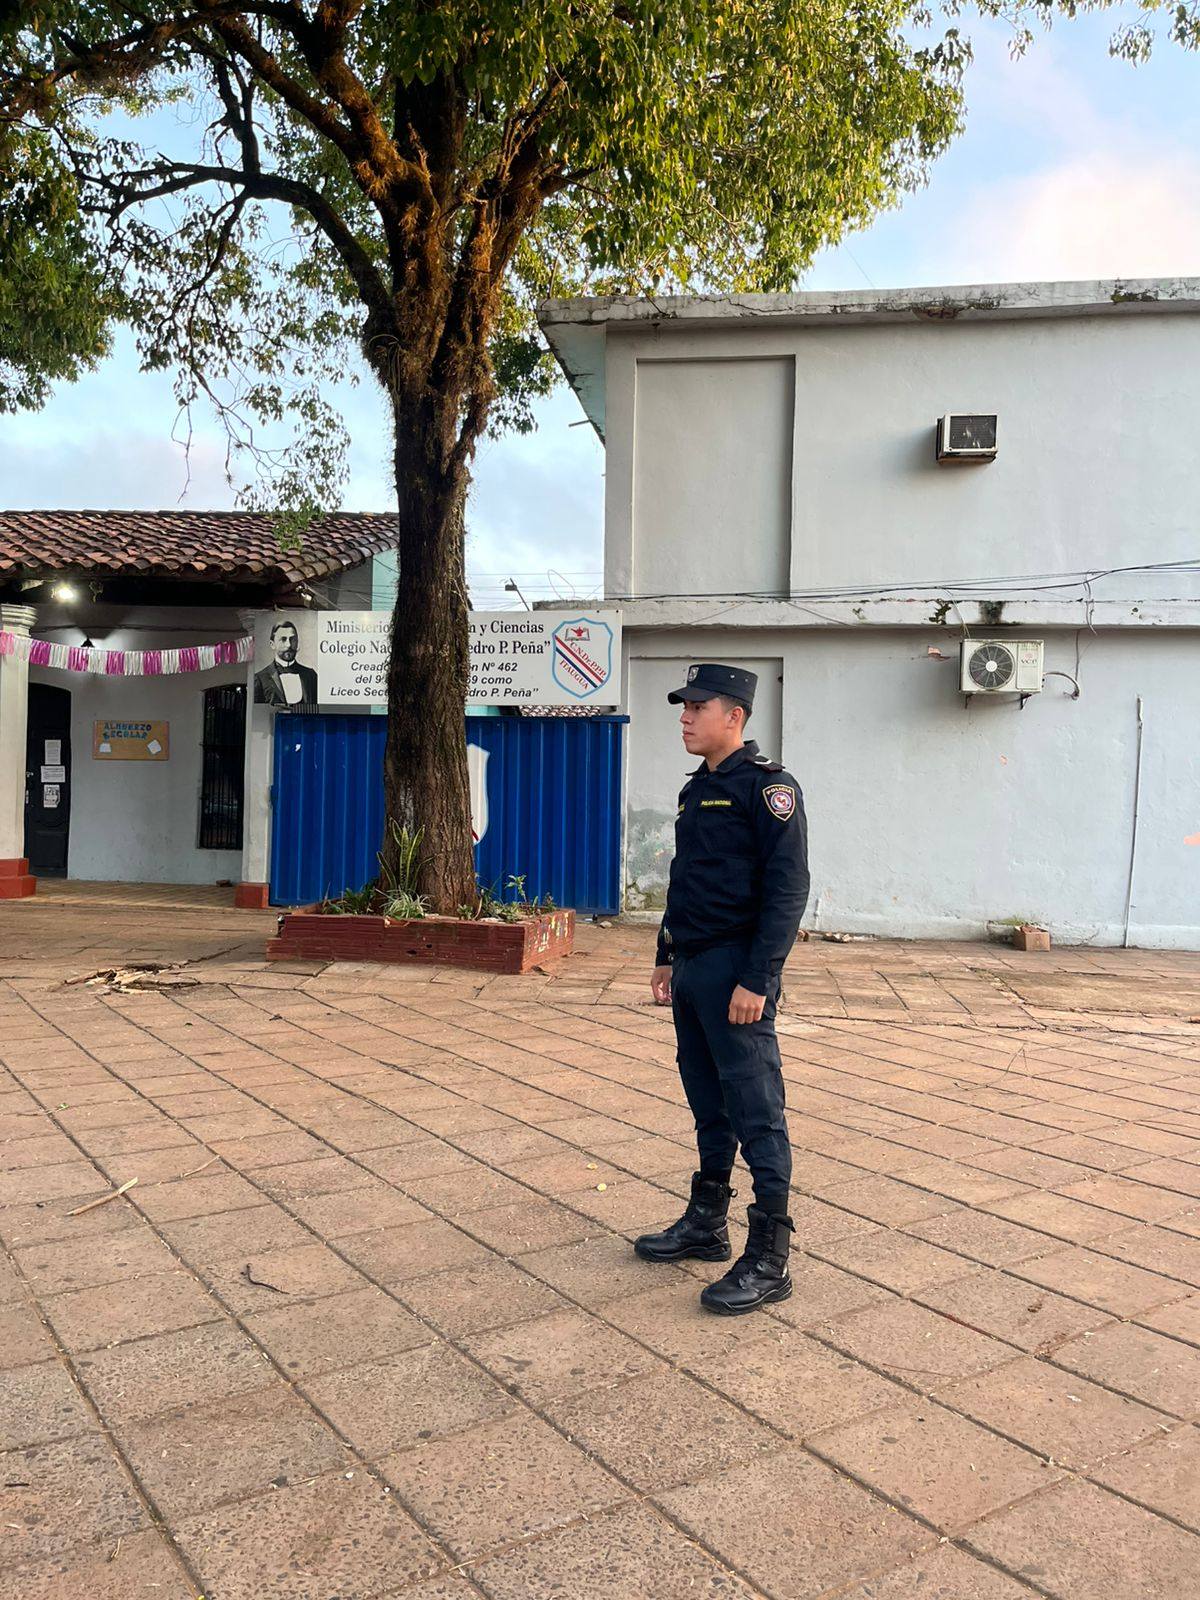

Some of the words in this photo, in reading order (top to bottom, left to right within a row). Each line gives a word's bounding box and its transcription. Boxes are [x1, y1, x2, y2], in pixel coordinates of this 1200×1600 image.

[327, 621, 391, 633] Ministerio
[479, 624, 487, 636] y
[490, 620, 544, 633] Ciencias
[320, 640, 366, 657] Colegio
[468, 640, 495, 654] edro
[499, 640, 508, 654] P.
[497, 662, 518, 671] 462
[355, 674, 372, 684] del
[481, 676, 512, 684] como
[330, 687, 360, 696] Liceo
